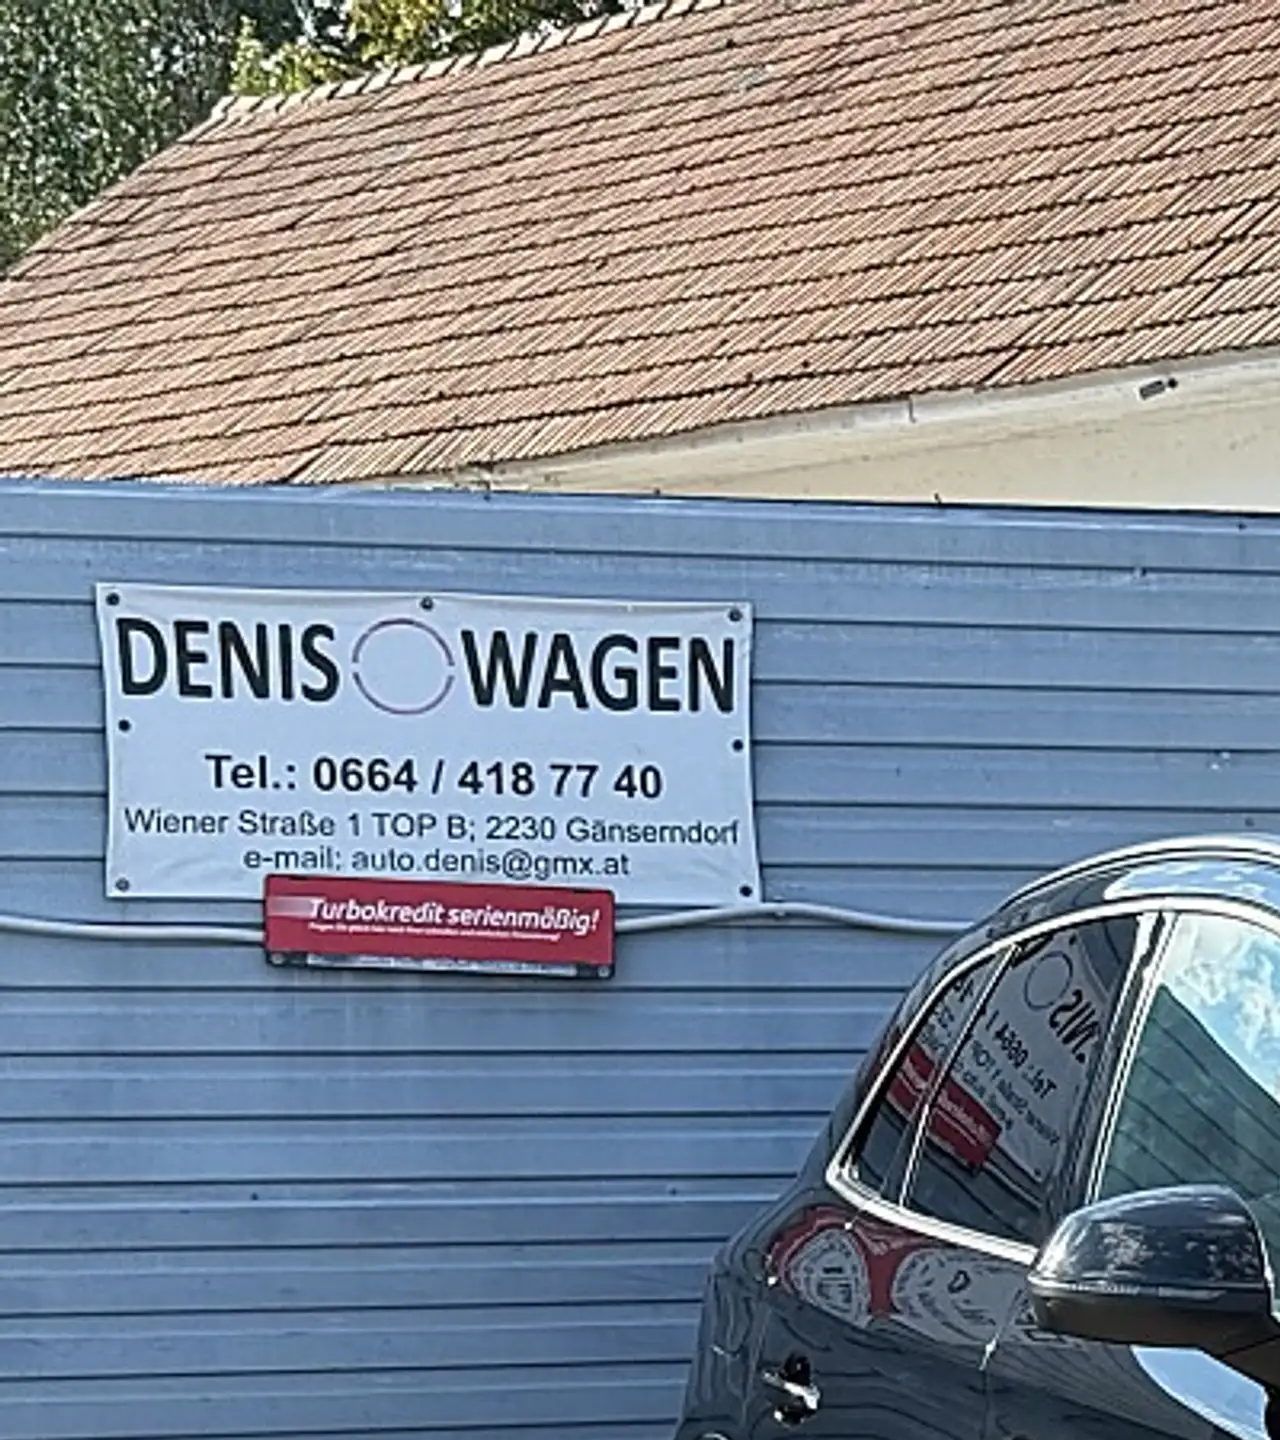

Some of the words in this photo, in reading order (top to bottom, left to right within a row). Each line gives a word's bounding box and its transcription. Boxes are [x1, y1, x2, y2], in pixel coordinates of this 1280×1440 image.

[115, 617, 341, 701] DENIS
[460, 629, 735, 713] WAGEN
[204, 754, 296, 790] Tel.:
[312, 756, 417, 792] 0664
[431, 758, 445, 795] /
[457, 761, 534, 796] 418
[549, 763, 600, 798] 77
[613, 764, 664, 799] 40
[124, 806, 229, 834] Wiener
[238, 809, 335, 837] Straße
[348, 813, 360, 835] 1
[371, 812, 437, 838] TOP
[447, 815, 476, 844] B;
[485, 815, 556, 842] 2230
[566, 815, 740, 845] Gänserndorf
[351, 849, 630, 880] auto.denis@gmx.at
[309, 898, 445, 924] Turbokredit
[447, 904, 600, 936] serienmäßig!
